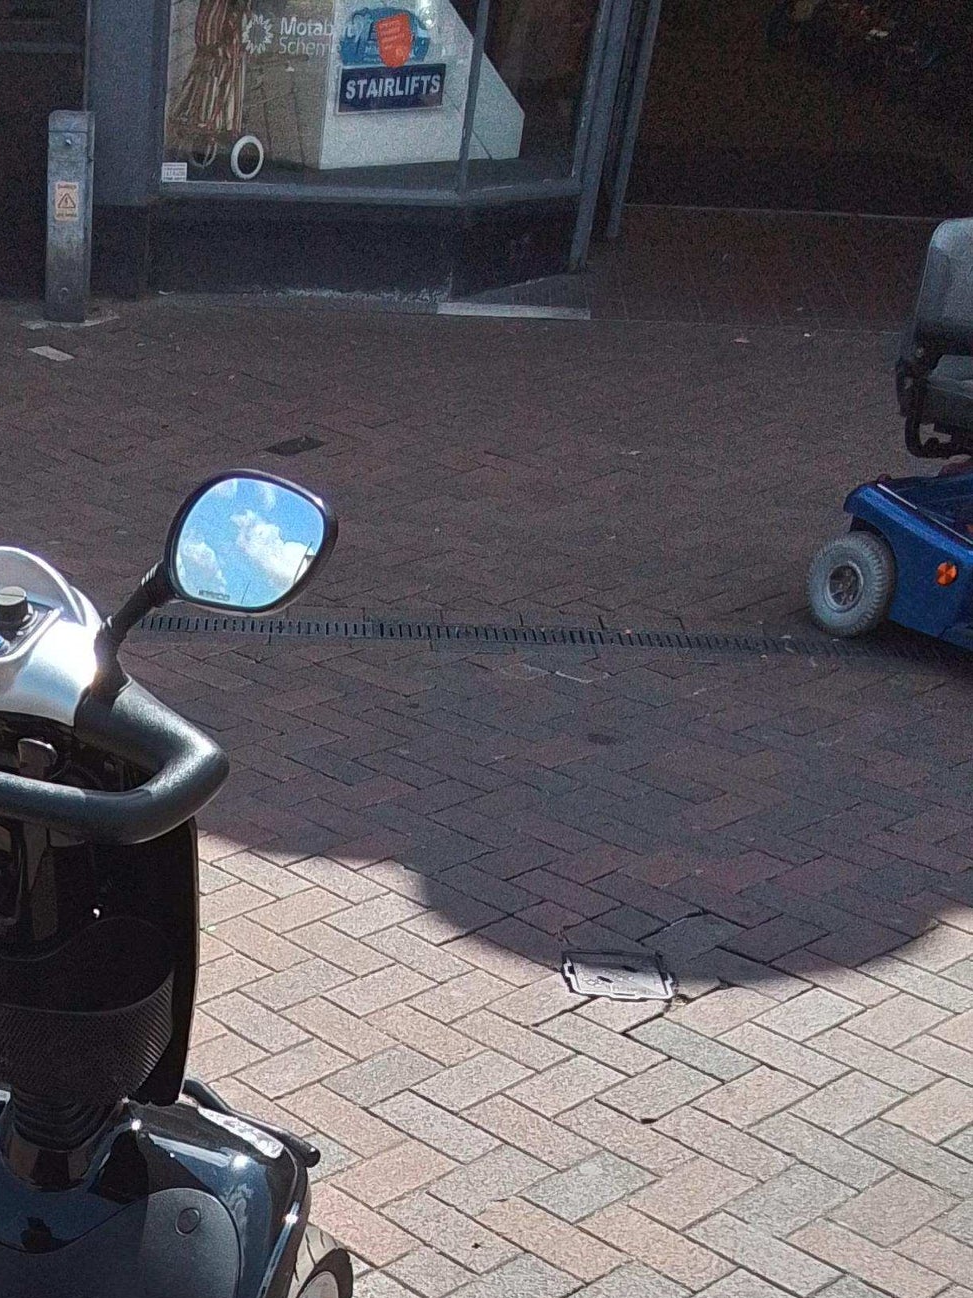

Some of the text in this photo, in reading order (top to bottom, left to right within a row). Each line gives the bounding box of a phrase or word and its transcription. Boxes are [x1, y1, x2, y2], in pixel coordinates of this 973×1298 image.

[280, 16, 363, 42] Motabity
[278, 36, 342, 55] Scheme
[345, 74, 441, 100] STAIRLIFTS
